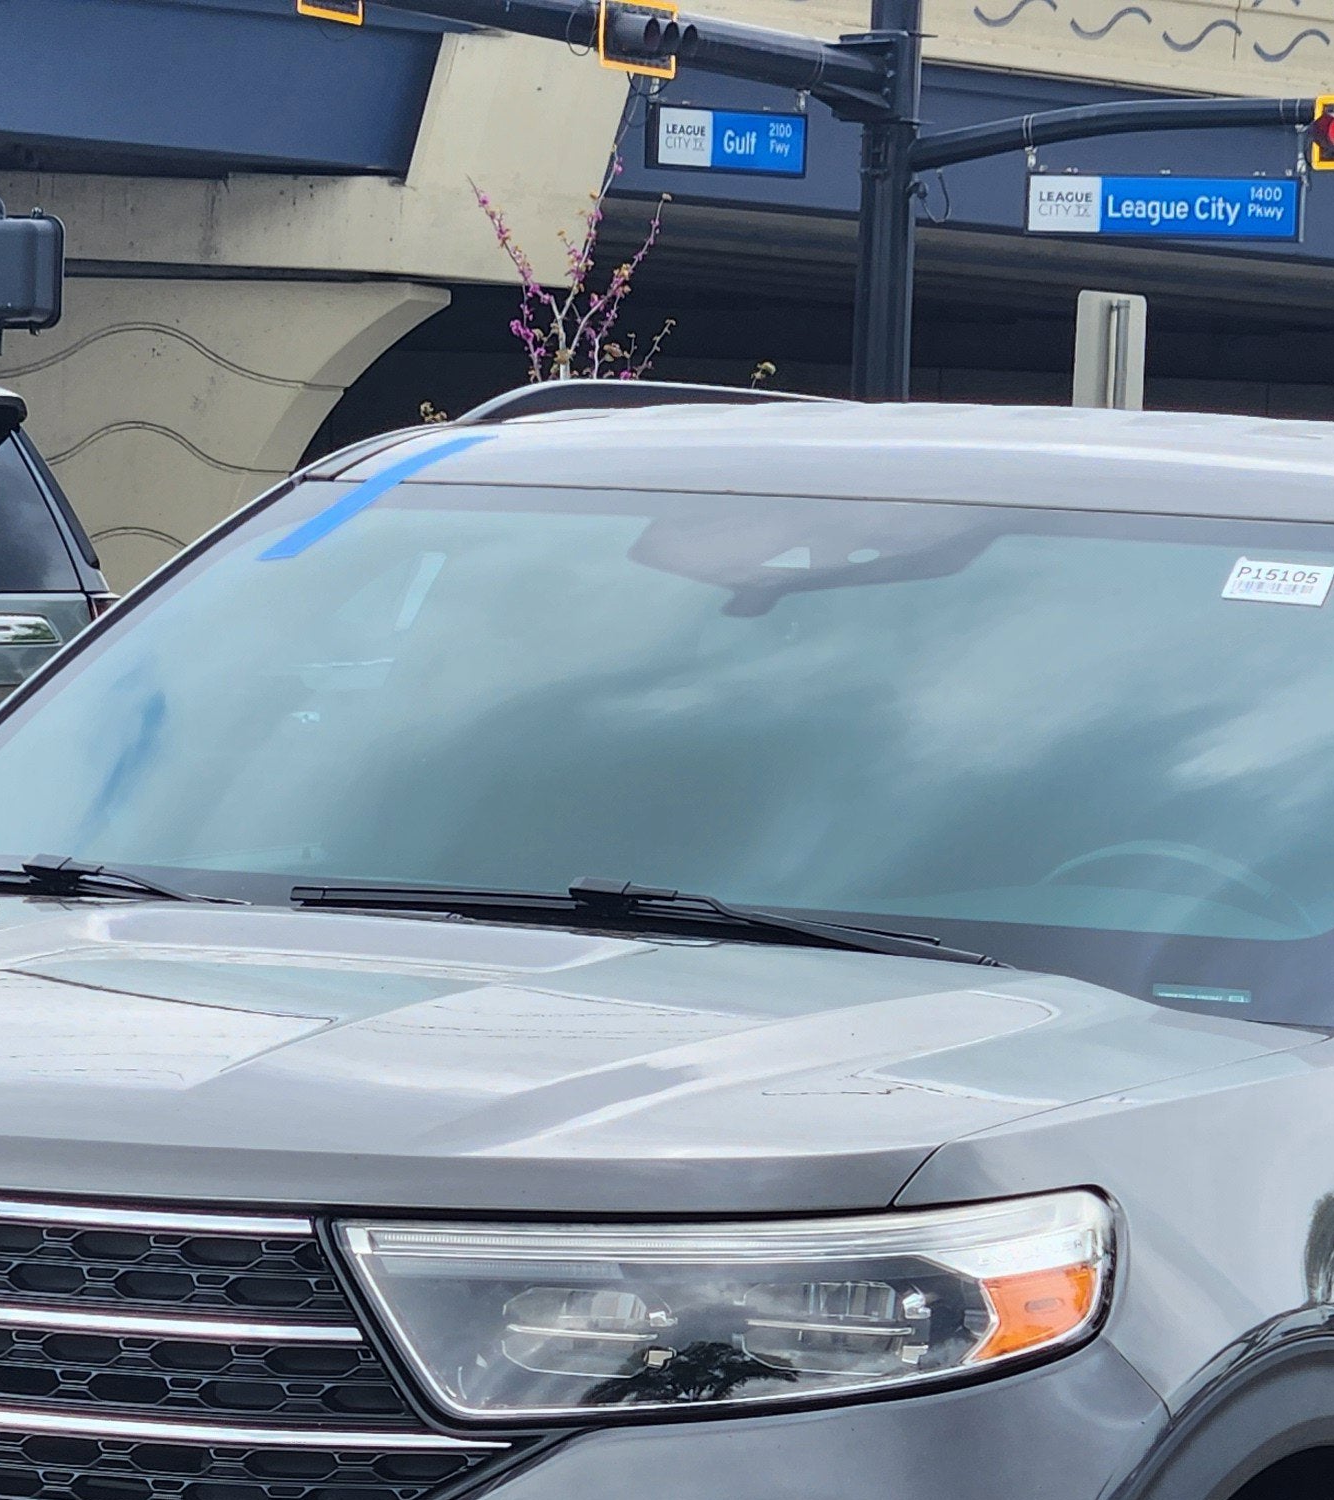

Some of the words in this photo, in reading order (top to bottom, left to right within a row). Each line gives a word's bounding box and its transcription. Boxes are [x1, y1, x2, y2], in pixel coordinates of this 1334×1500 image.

[666, 123, 706, 136] LEAGUE
[769, 122, 792, 138] 2100
[665, 136, 690, 149] CITY
[723, 129, 757, 155] Gulf
[769, 140, 790, 157] Fwy
[1039, 191, 1093, 203] LEAGUE
[1250, 186, 1282, 201] 1400
[1038, 204, 1071, 217] CITY
[1107, 194, 1188, 226] League
[1194, 195, 1240, 226] City
[1247, 204, 1284, 220] Pkwy
[1236, 566, 1321, 584] P15105
